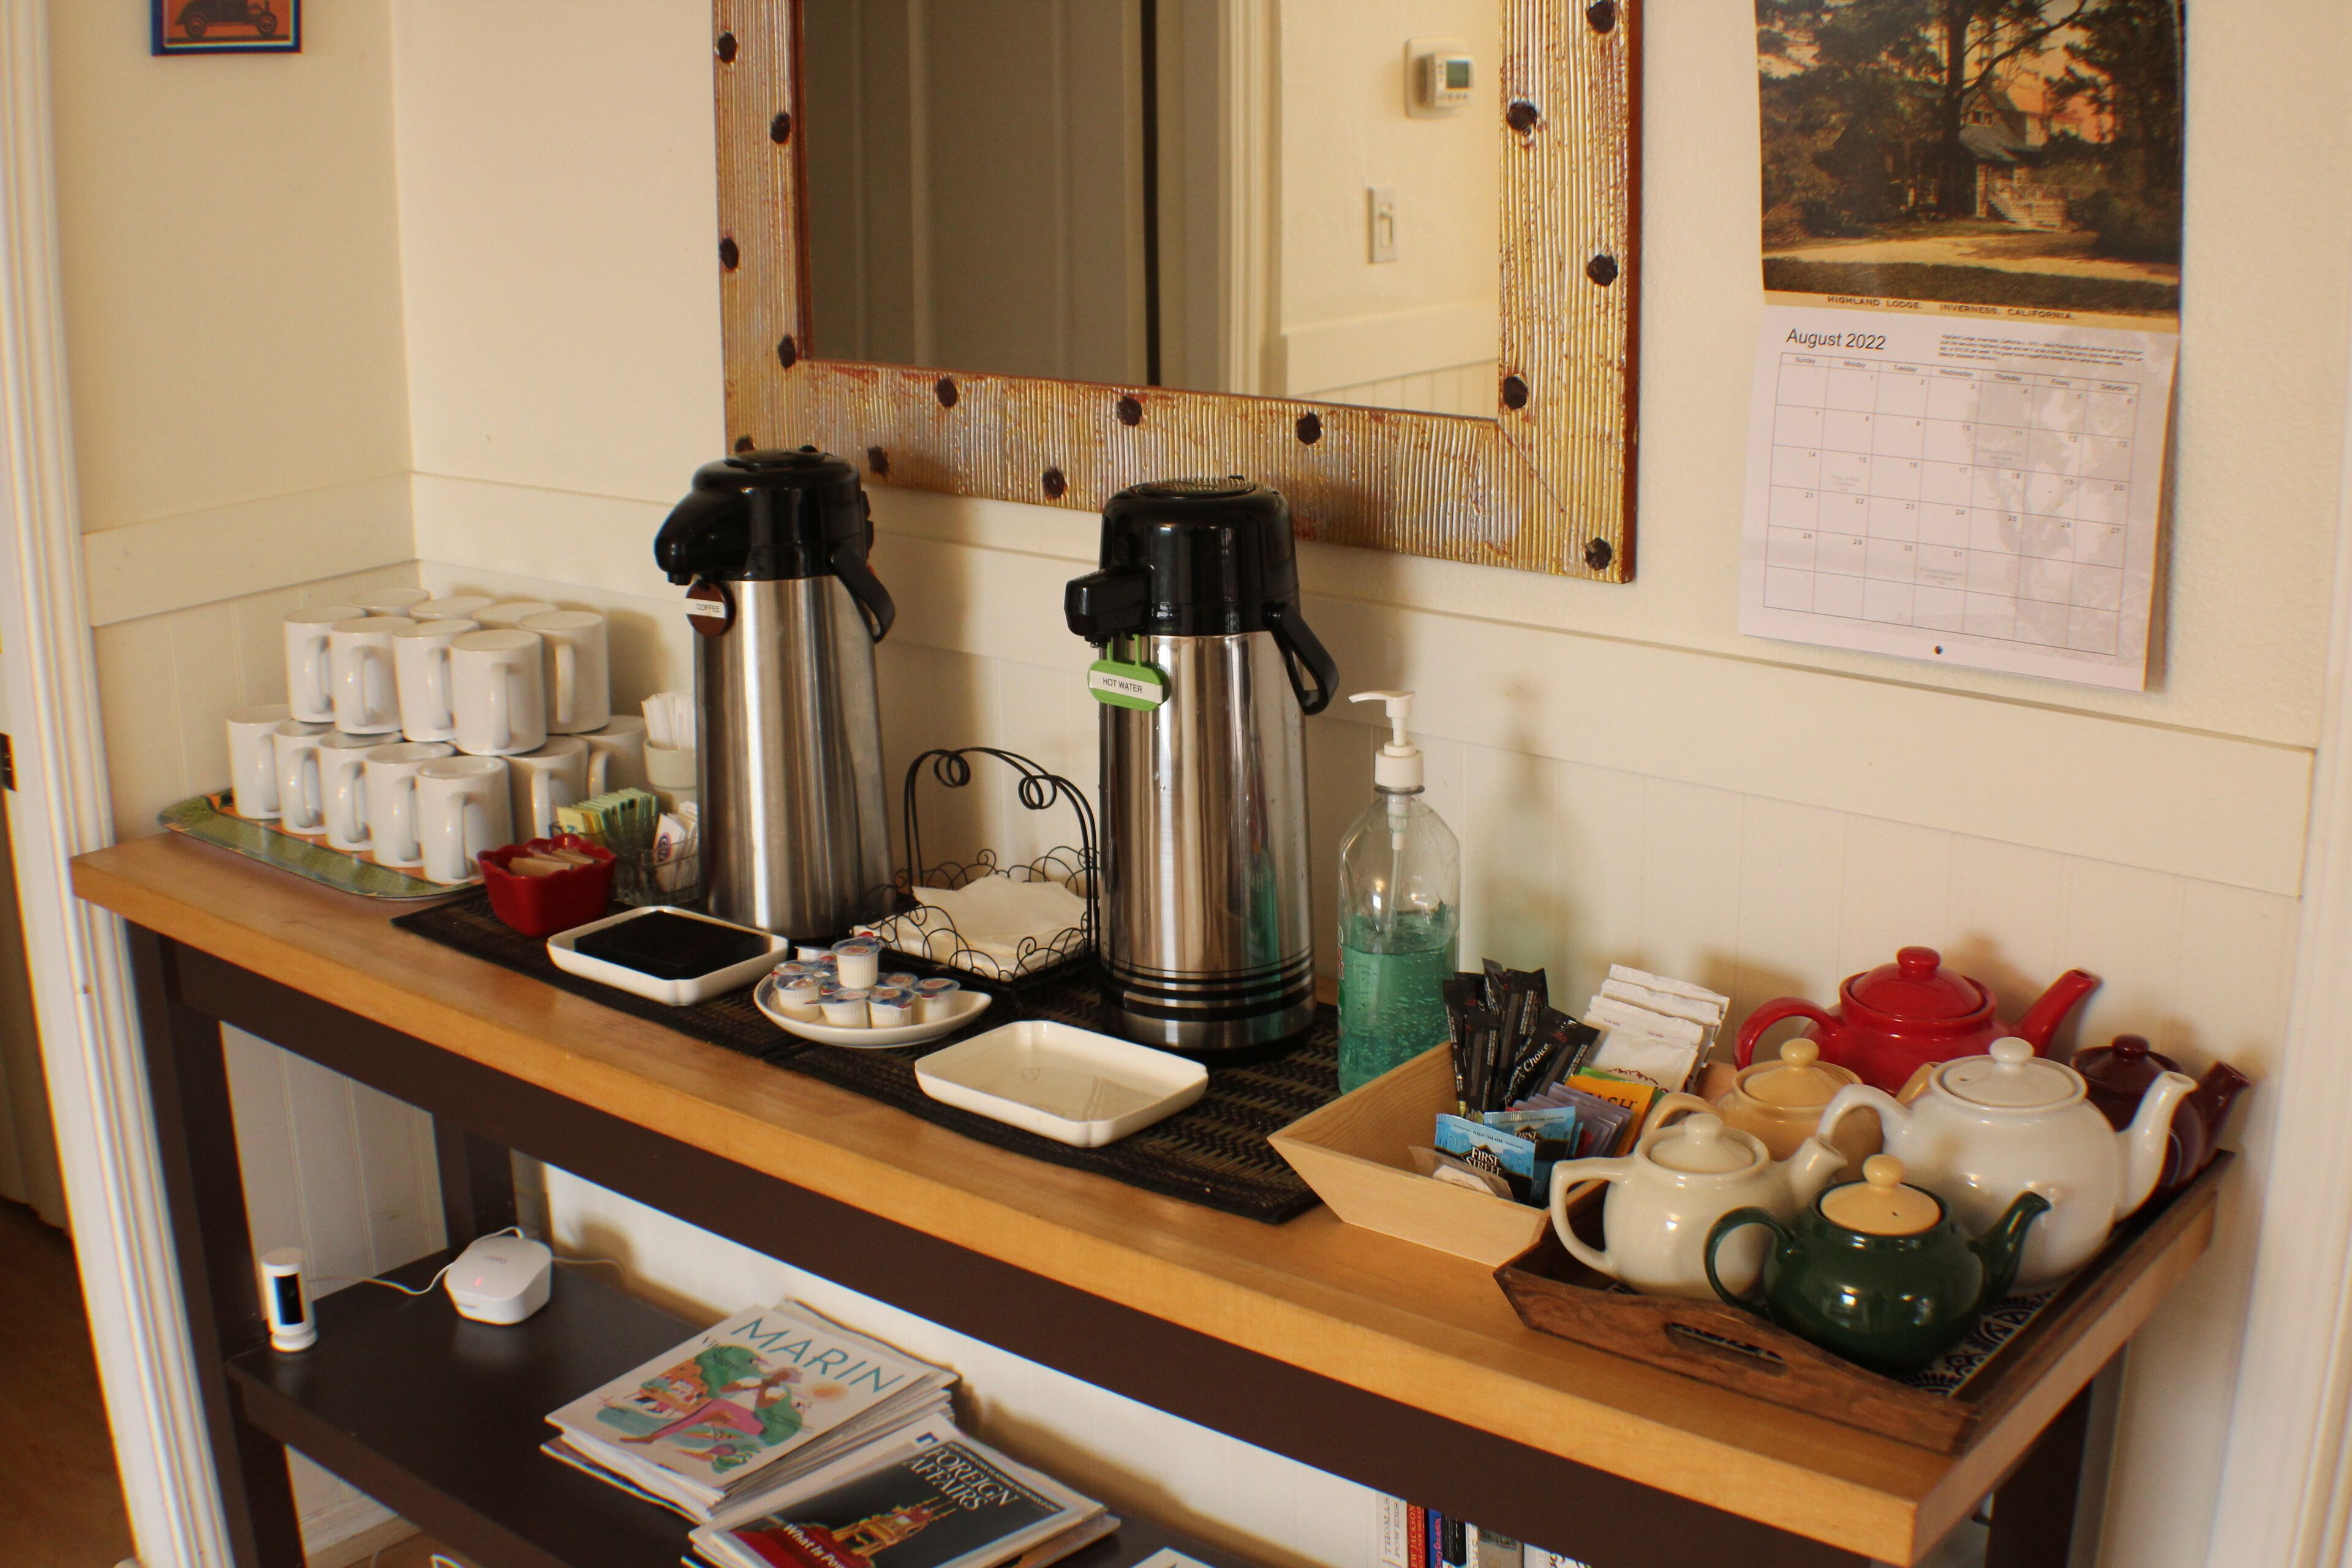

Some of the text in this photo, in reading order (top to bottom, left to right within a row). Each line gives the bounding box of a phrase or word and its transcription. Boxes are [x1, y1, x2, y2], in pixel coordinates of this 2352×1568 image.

[1827, 295, 1880, 306] HIGHLAND
[1786, 328, 1886, 350] August 2022
[1795, 356, 1815, 365] Sunday
[1843, 360, 1866, 369] Monday
[1894, 364, 1917, 373] Tuesday
[1940, 369, 1973, 378] Wednesday
[1995, 373, 2021, 382] Thursday
[2051, 377, 2070, 387] Friday
[696, 603, 720, 612] COFFEE
[1102, 677, 1142, 693] HOT WATER
[1466, 1156, 1502, 1177] STREET
[1471, 1145, 1500, 1166] FIRST
[730, 1317, 905, 1393] MARIN
[902, 1457, 988, 1510] AFFAIRS
[923, 1447, 1020, 1507] FOREIGN
[783, 1523, 816, 1550] What
[1409, 1504, 1418, 1551] JACKSON
